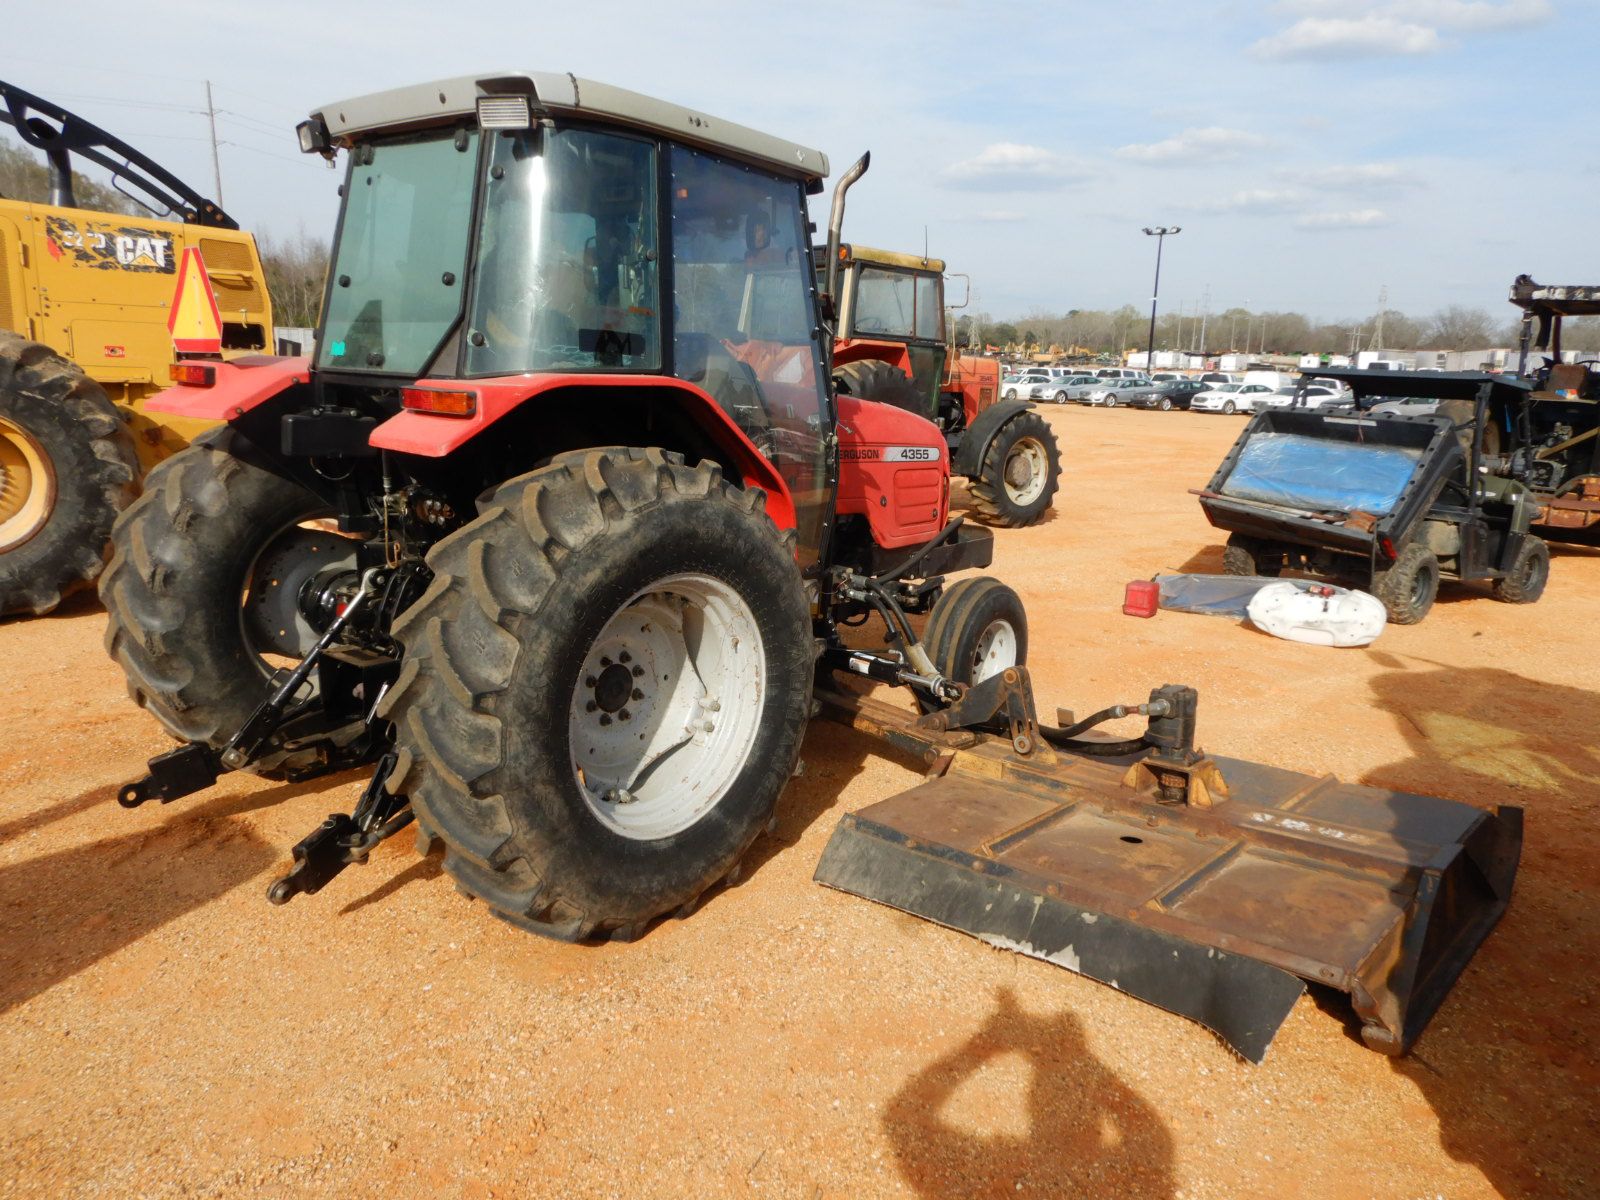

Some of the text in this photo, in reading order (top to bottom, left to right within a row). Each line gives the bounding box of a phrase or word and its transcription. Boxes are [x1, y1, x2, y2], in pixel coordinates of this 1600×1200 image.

[116, 235, 168, 268] CAT
[839, 448, 929, 460] ERGUSON 4355
